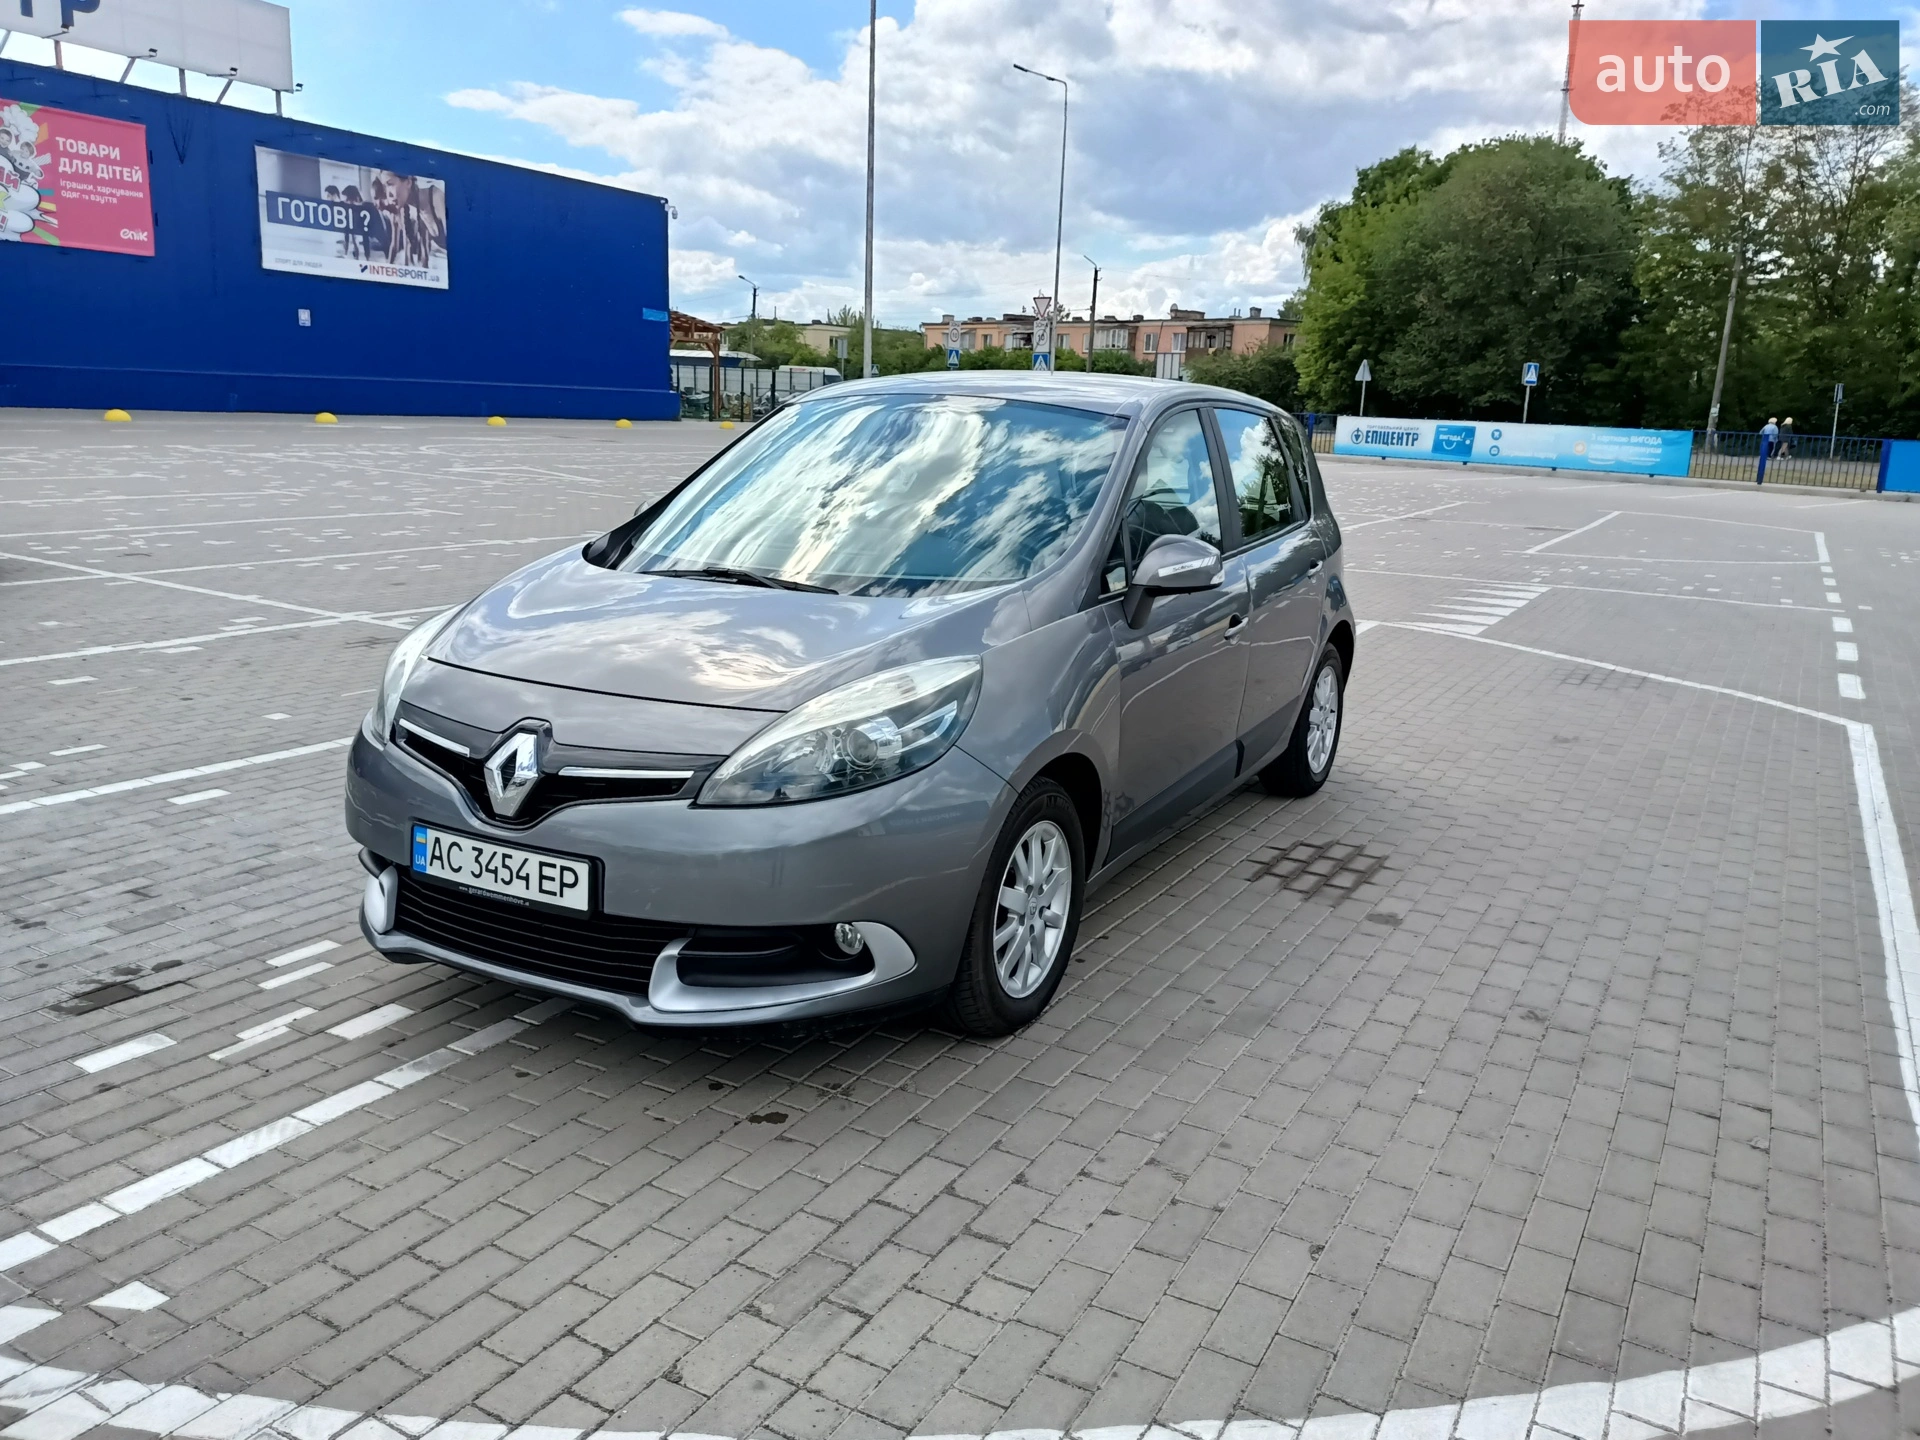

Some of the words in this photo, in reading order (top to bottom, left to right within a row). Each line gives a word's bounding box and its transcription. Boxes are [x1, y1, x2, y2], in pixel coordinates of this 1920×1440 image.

[55, 136, 121, 161] ТОВАРИ
[58, 157, 93, 176] ДЛЯ
[96, 163, 143, 183] ДІТЕЙ
[61, 190, 80, 200] одяг
[90, 194, 118, 205] взуття
[97, 185, 144, 200] харчування
[277, 196, 354, 230] ГОТОВІ
[359, 209, 371, 232] ?
[369, 265, 440, 283] INTERSPORT.ua
[1365, 430, 1419, 446] ЕПІЦЕНТР
[1630, 435, 1662, 446] ВИГОДА
[415, 855, 426, 866] UA
[429, 836, 463, 873] AC
[470, 845, 530, 891] 3454
[538, 860, 579, 898] EP
